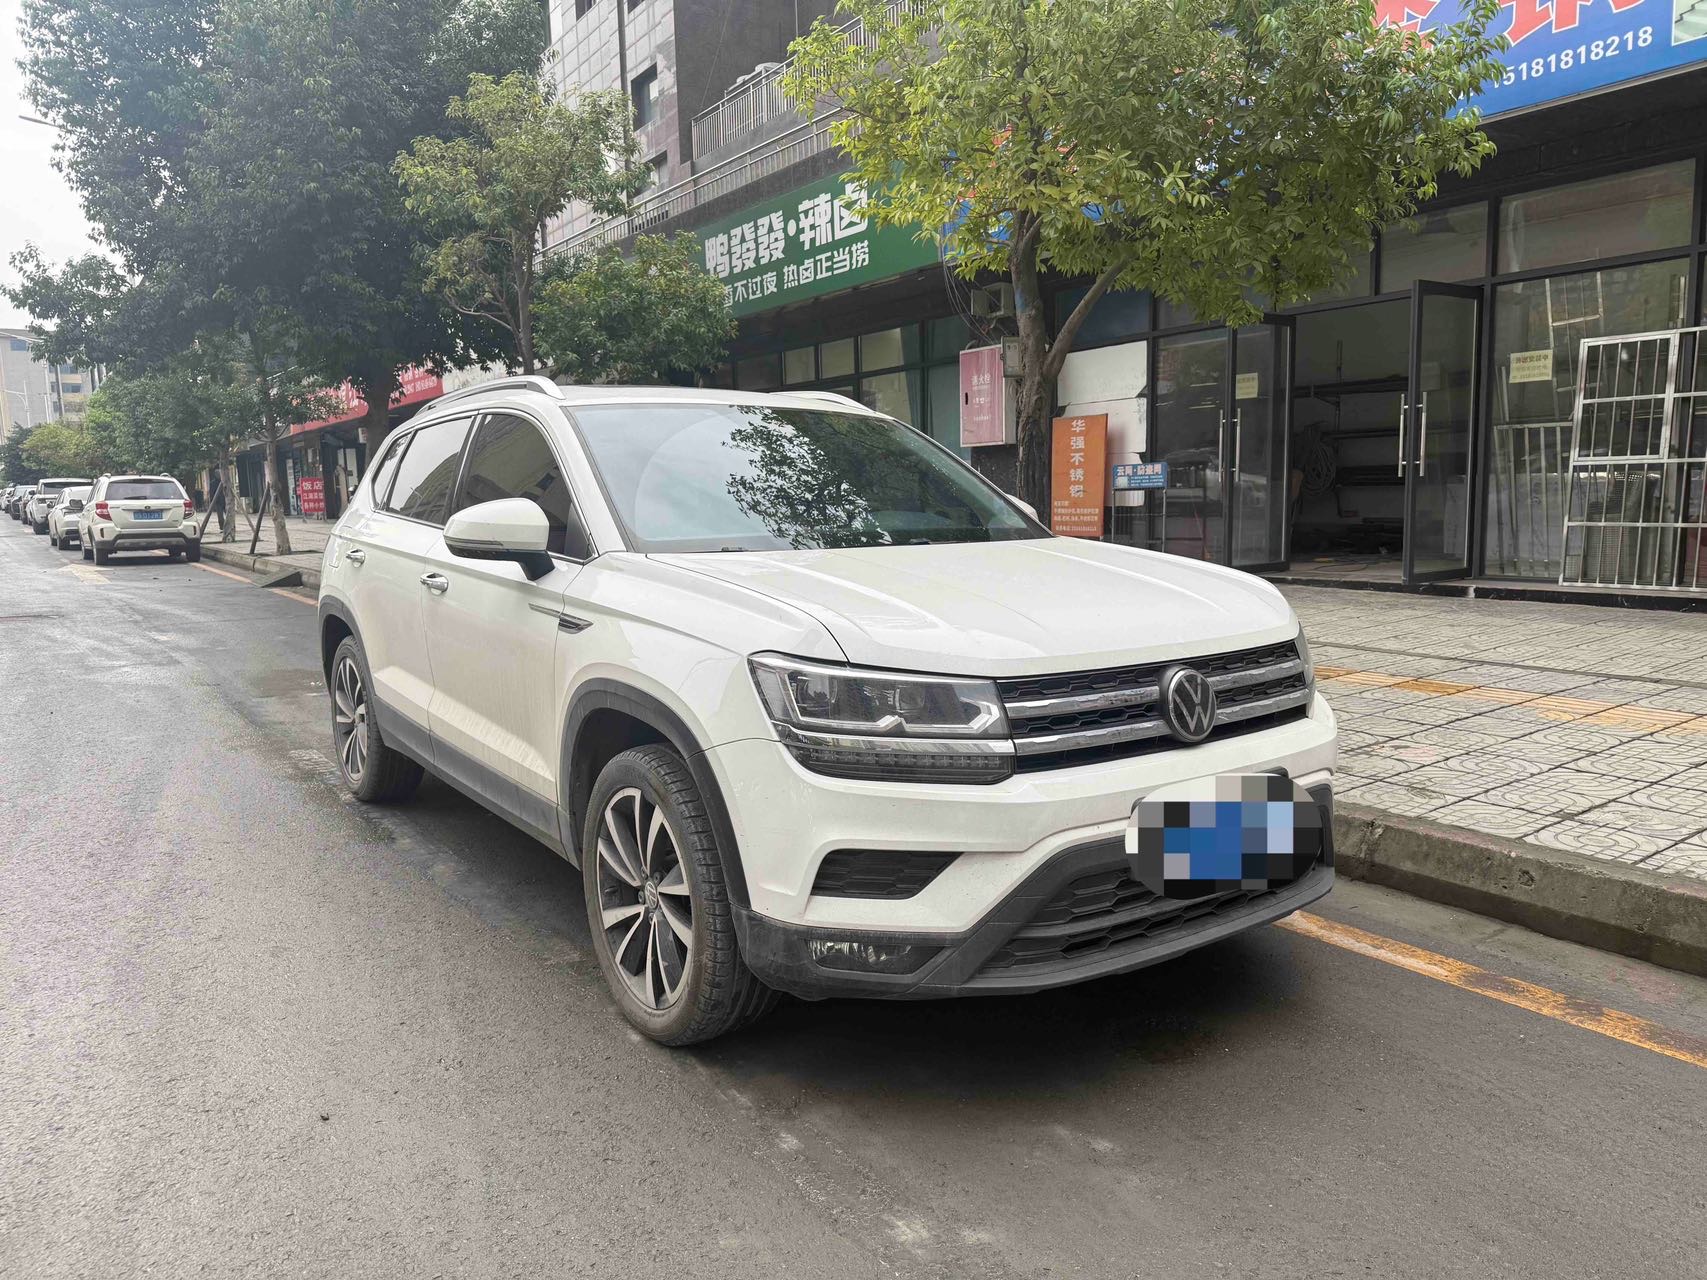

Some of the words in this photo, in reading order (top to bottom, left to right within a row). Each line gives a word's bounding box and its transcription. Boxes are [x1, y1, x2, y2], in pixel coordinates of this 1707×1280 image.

[783, 240, 870, 289] 热卤正当捞
[1069, 419, 1086, 498] 华强不锈钢
[302, 481, 325, 490] 饭店
